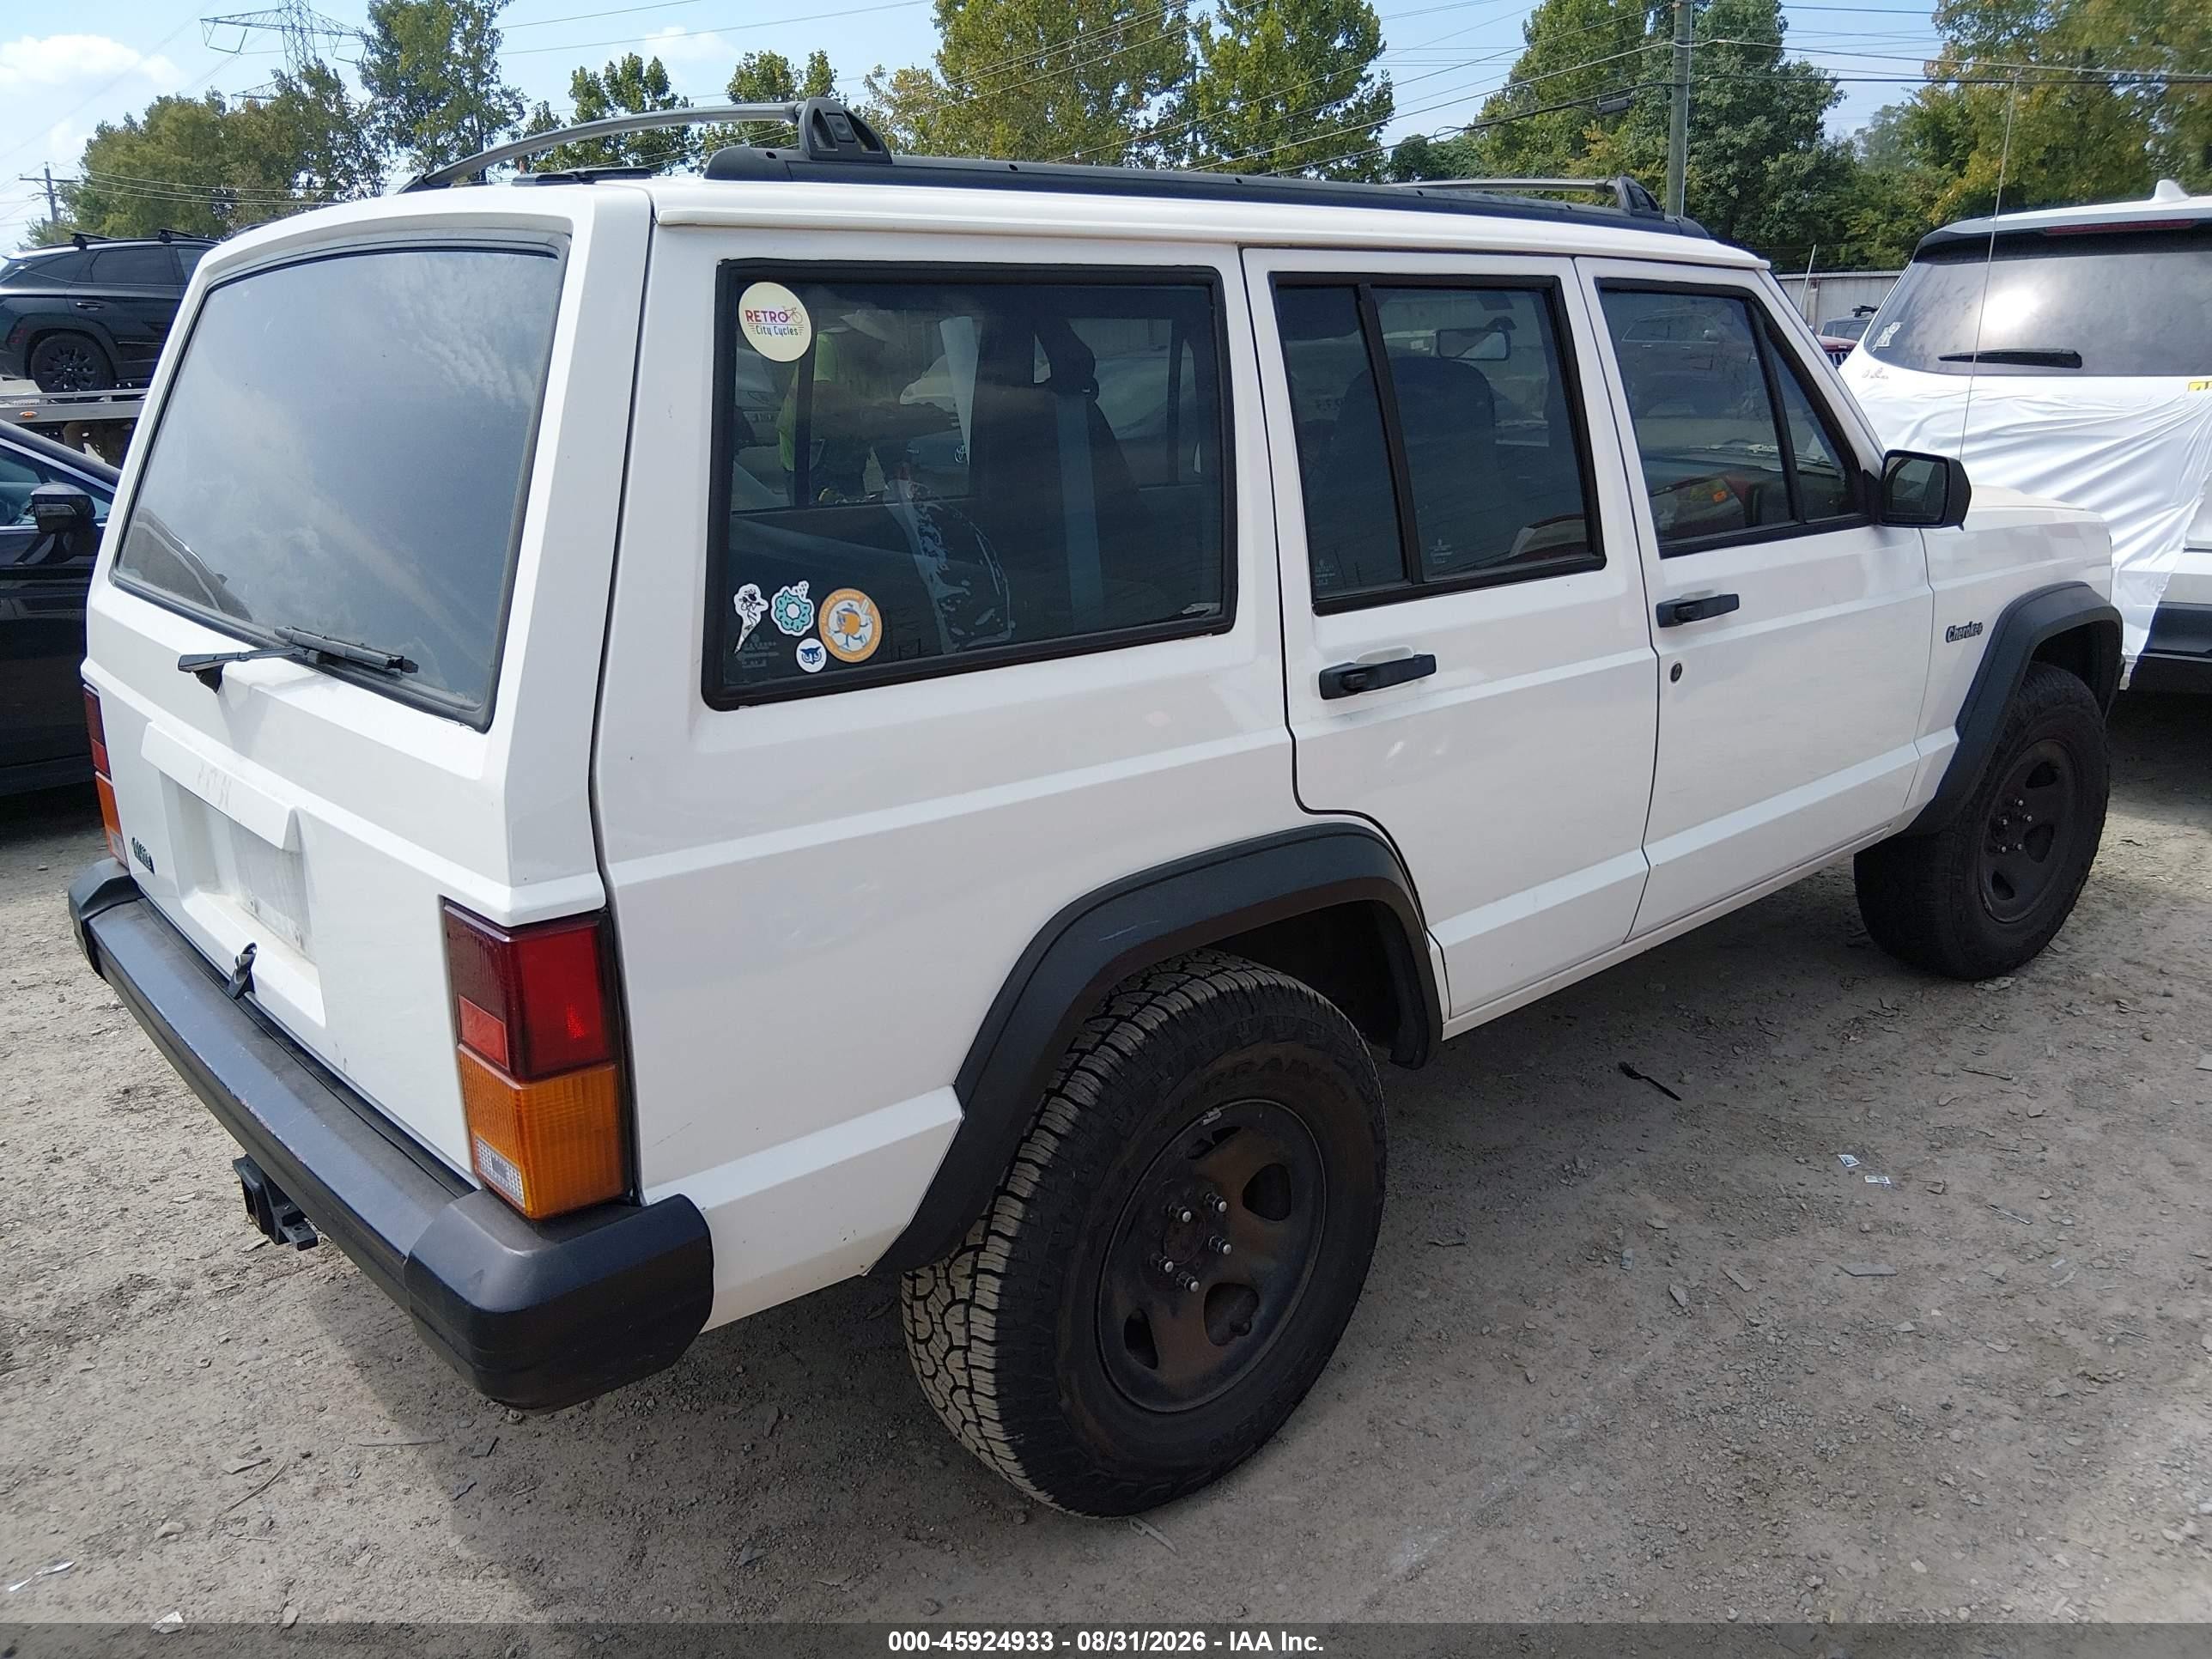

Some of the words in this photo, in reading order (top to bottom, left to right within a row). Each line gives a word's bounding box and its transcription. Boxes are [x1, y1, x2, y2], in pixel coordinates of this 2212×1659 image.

[744, 310, 788, 323] RETRO
[756, 325, 773, 337] City
[774, 326, 799, 337] Cycles
[1946, 620, 1984, 643] Cherokee
